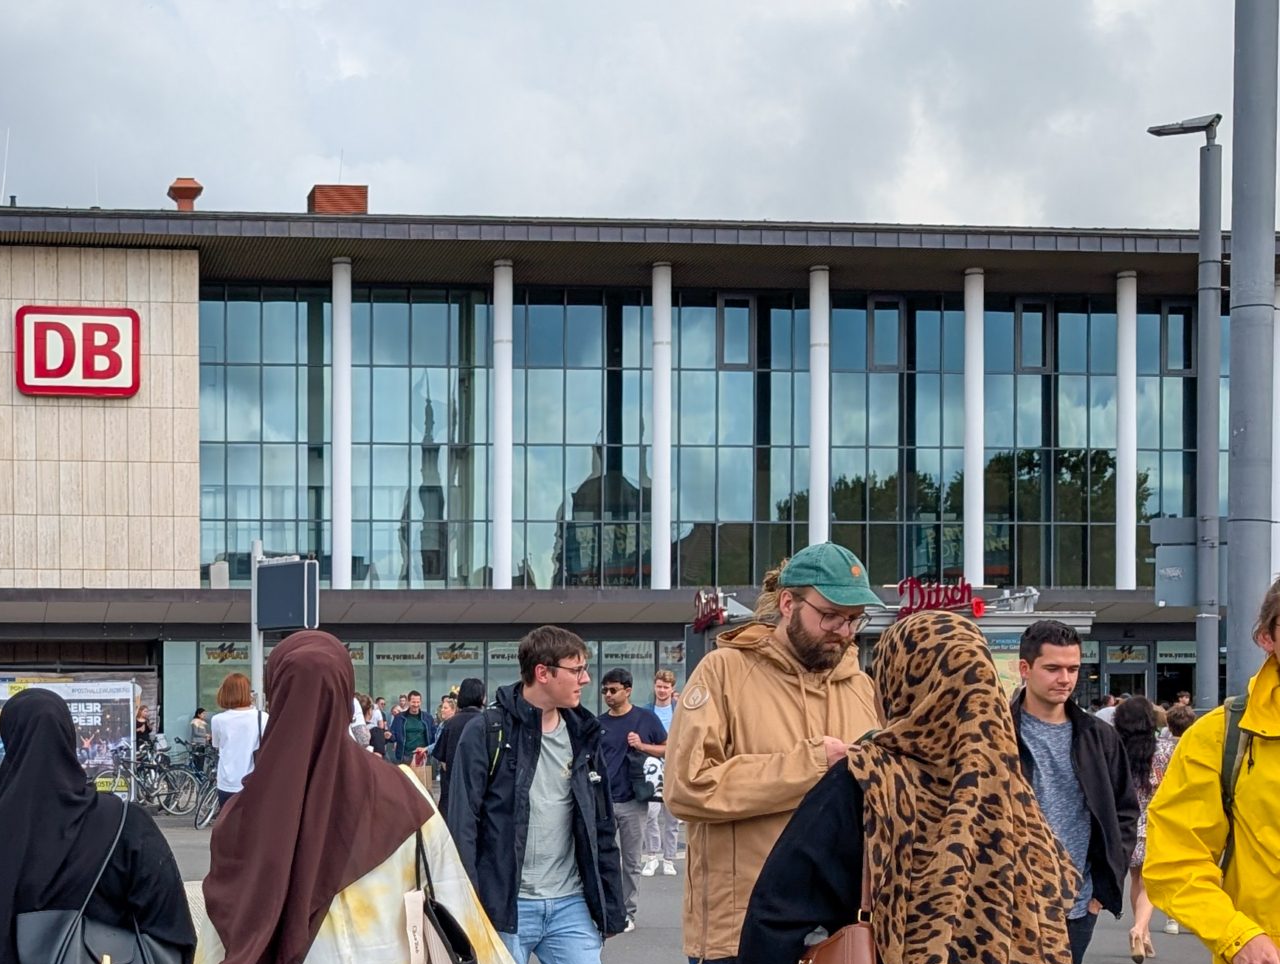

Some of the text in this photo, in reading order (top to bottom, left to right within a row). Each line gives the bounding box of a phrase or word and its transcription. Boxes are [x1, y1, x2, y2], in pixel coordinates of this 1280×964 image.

[34, 321, 123, 379] DB
[896, 576, 973, 622] Ditsch
[375, 651, 425, 662] www.yormas.de
[604, 651, 653, 661] www.yormas.de
[1159, 652, 1197, 660] www.yormas.
